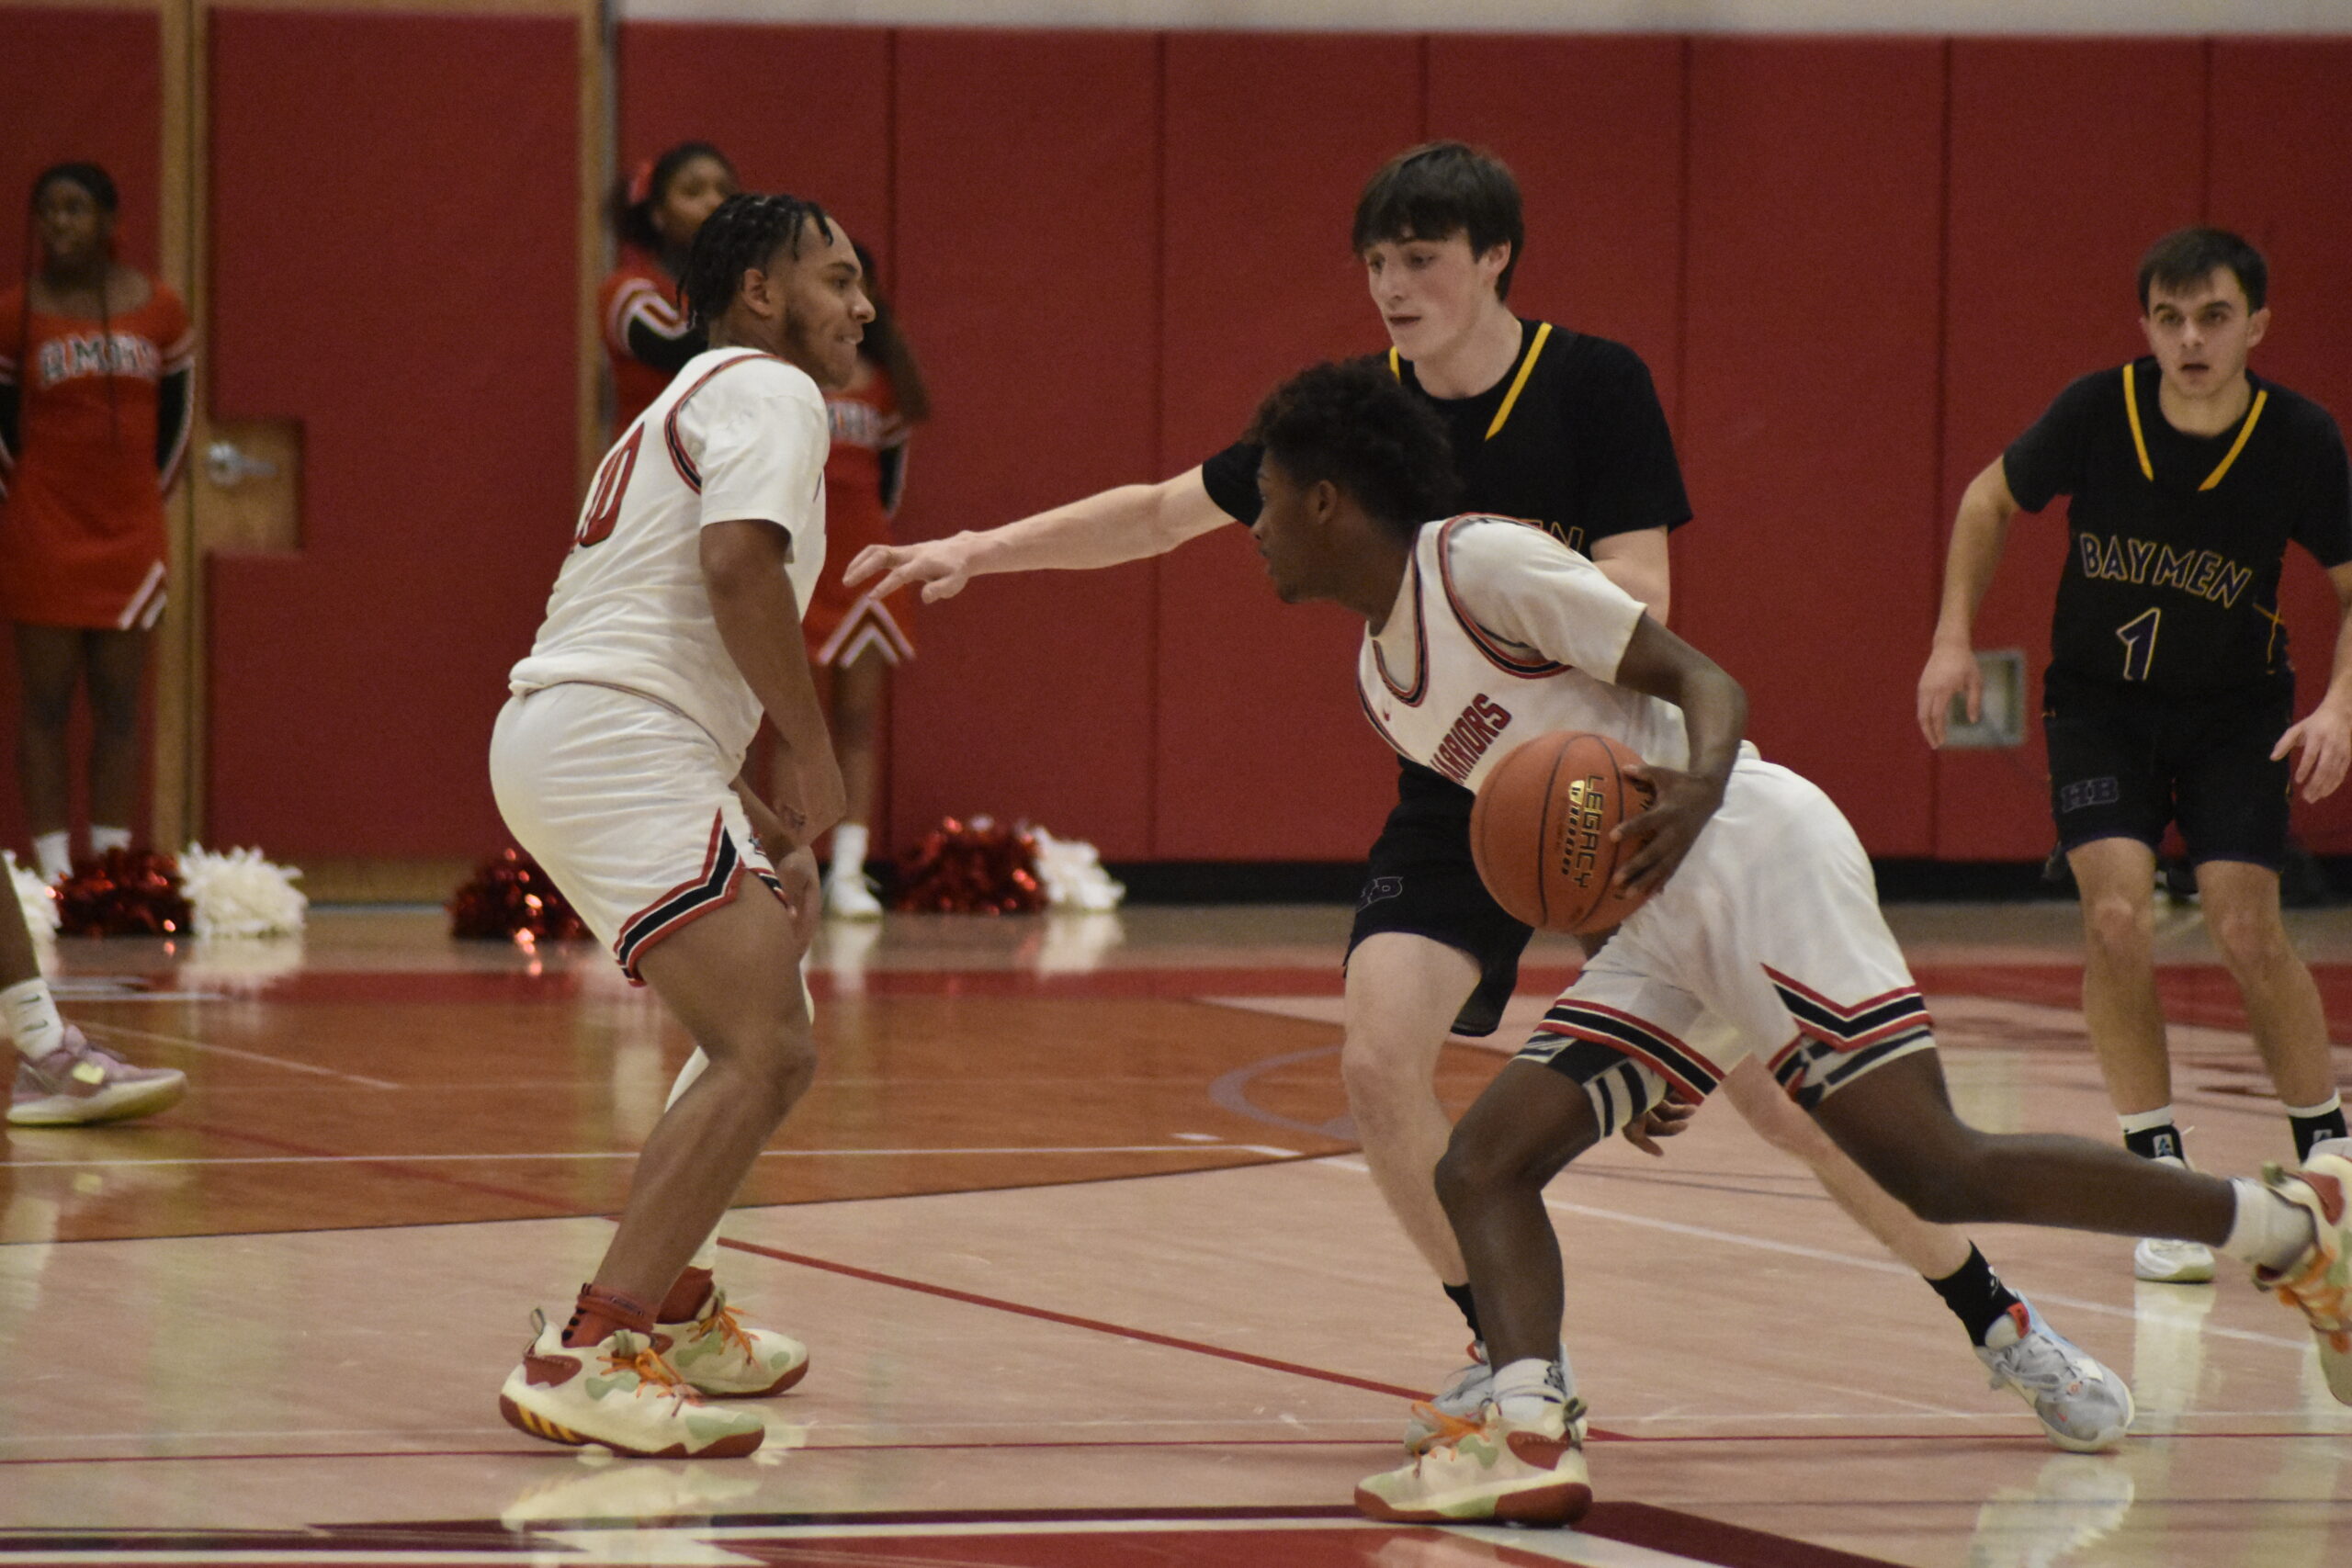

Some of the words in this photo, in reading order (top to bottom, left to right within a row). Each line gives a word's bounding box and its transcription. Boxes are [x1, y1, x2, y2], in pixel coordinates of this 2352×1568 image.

[2079, 532, 2253, 609] BAYMEN
[2115, 606, 2161, 682] 1
[1574, 773, 1605, 889] LEGACY
